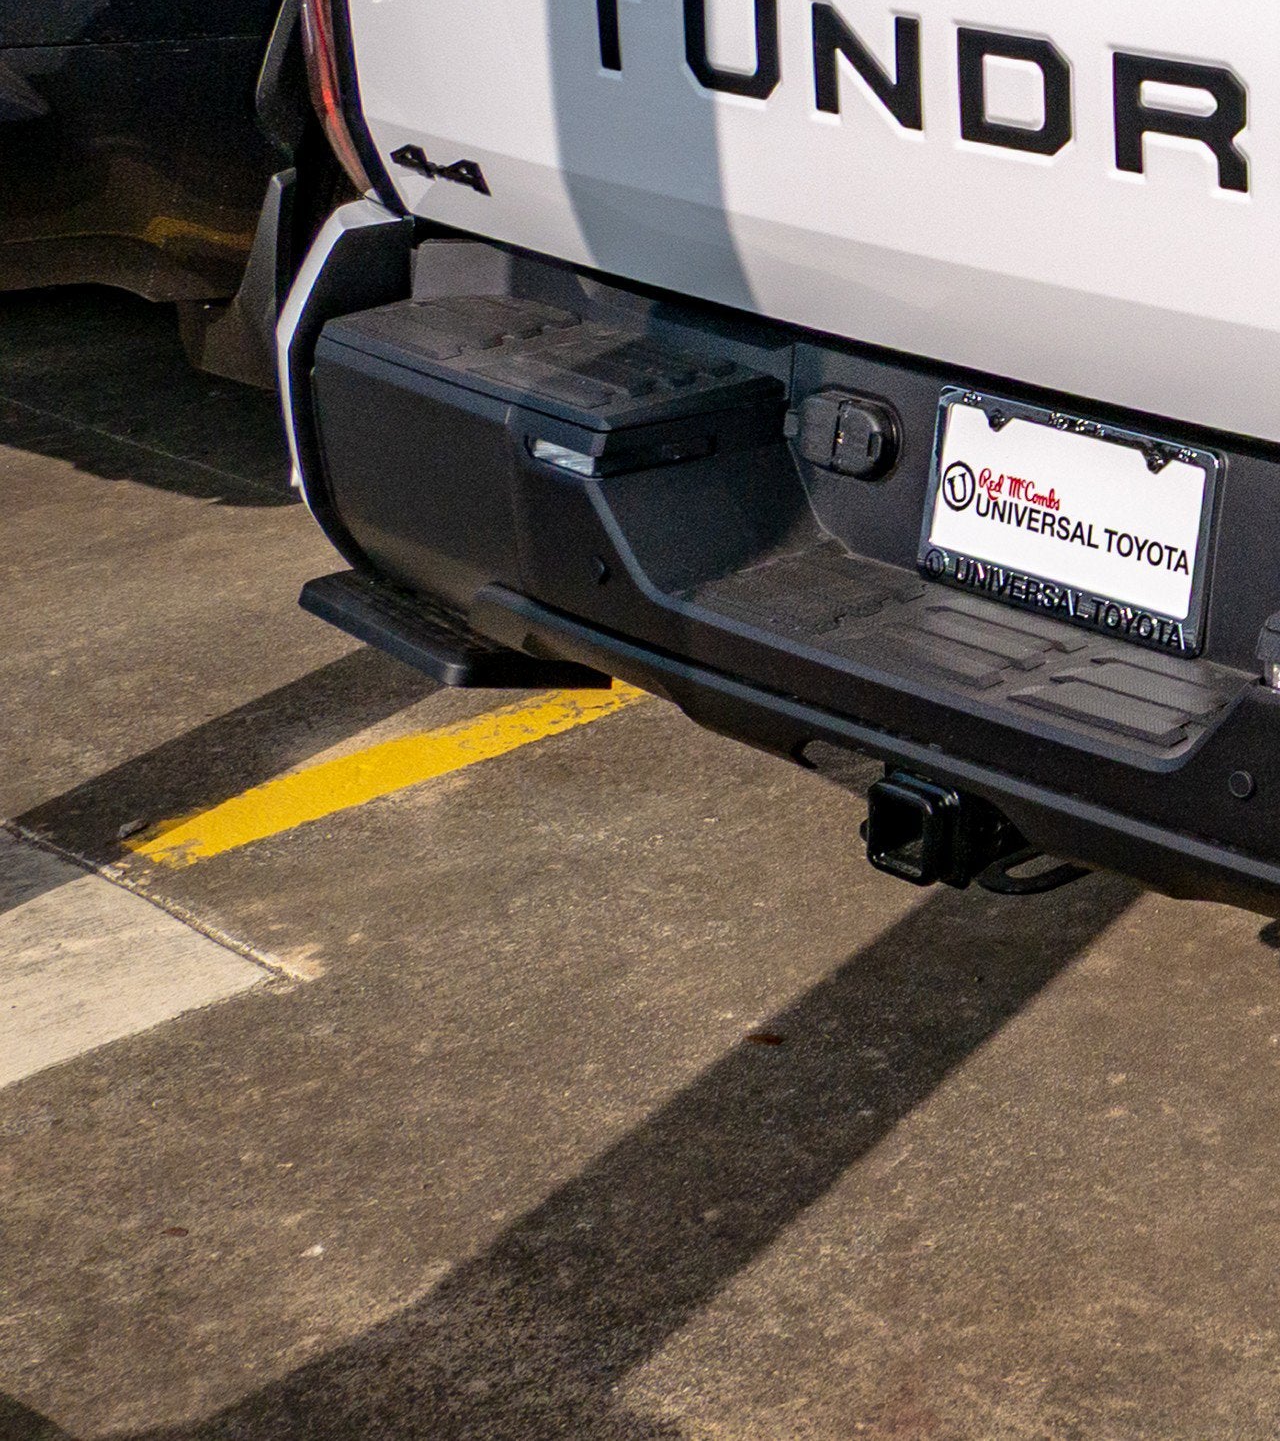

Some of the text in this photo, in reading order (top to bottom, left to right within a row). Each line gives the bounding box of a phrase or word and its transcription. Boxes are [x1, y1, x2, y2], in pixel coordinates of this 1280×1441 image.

[978, 467, 1061, 511] Red McCombs
[975, 492, 1190, 576] UNIVERSAL TOYOTA
[954, 556, 1089, 620] UNIVERSAL
[1090, 596, 1186, 651] TOYOTA
